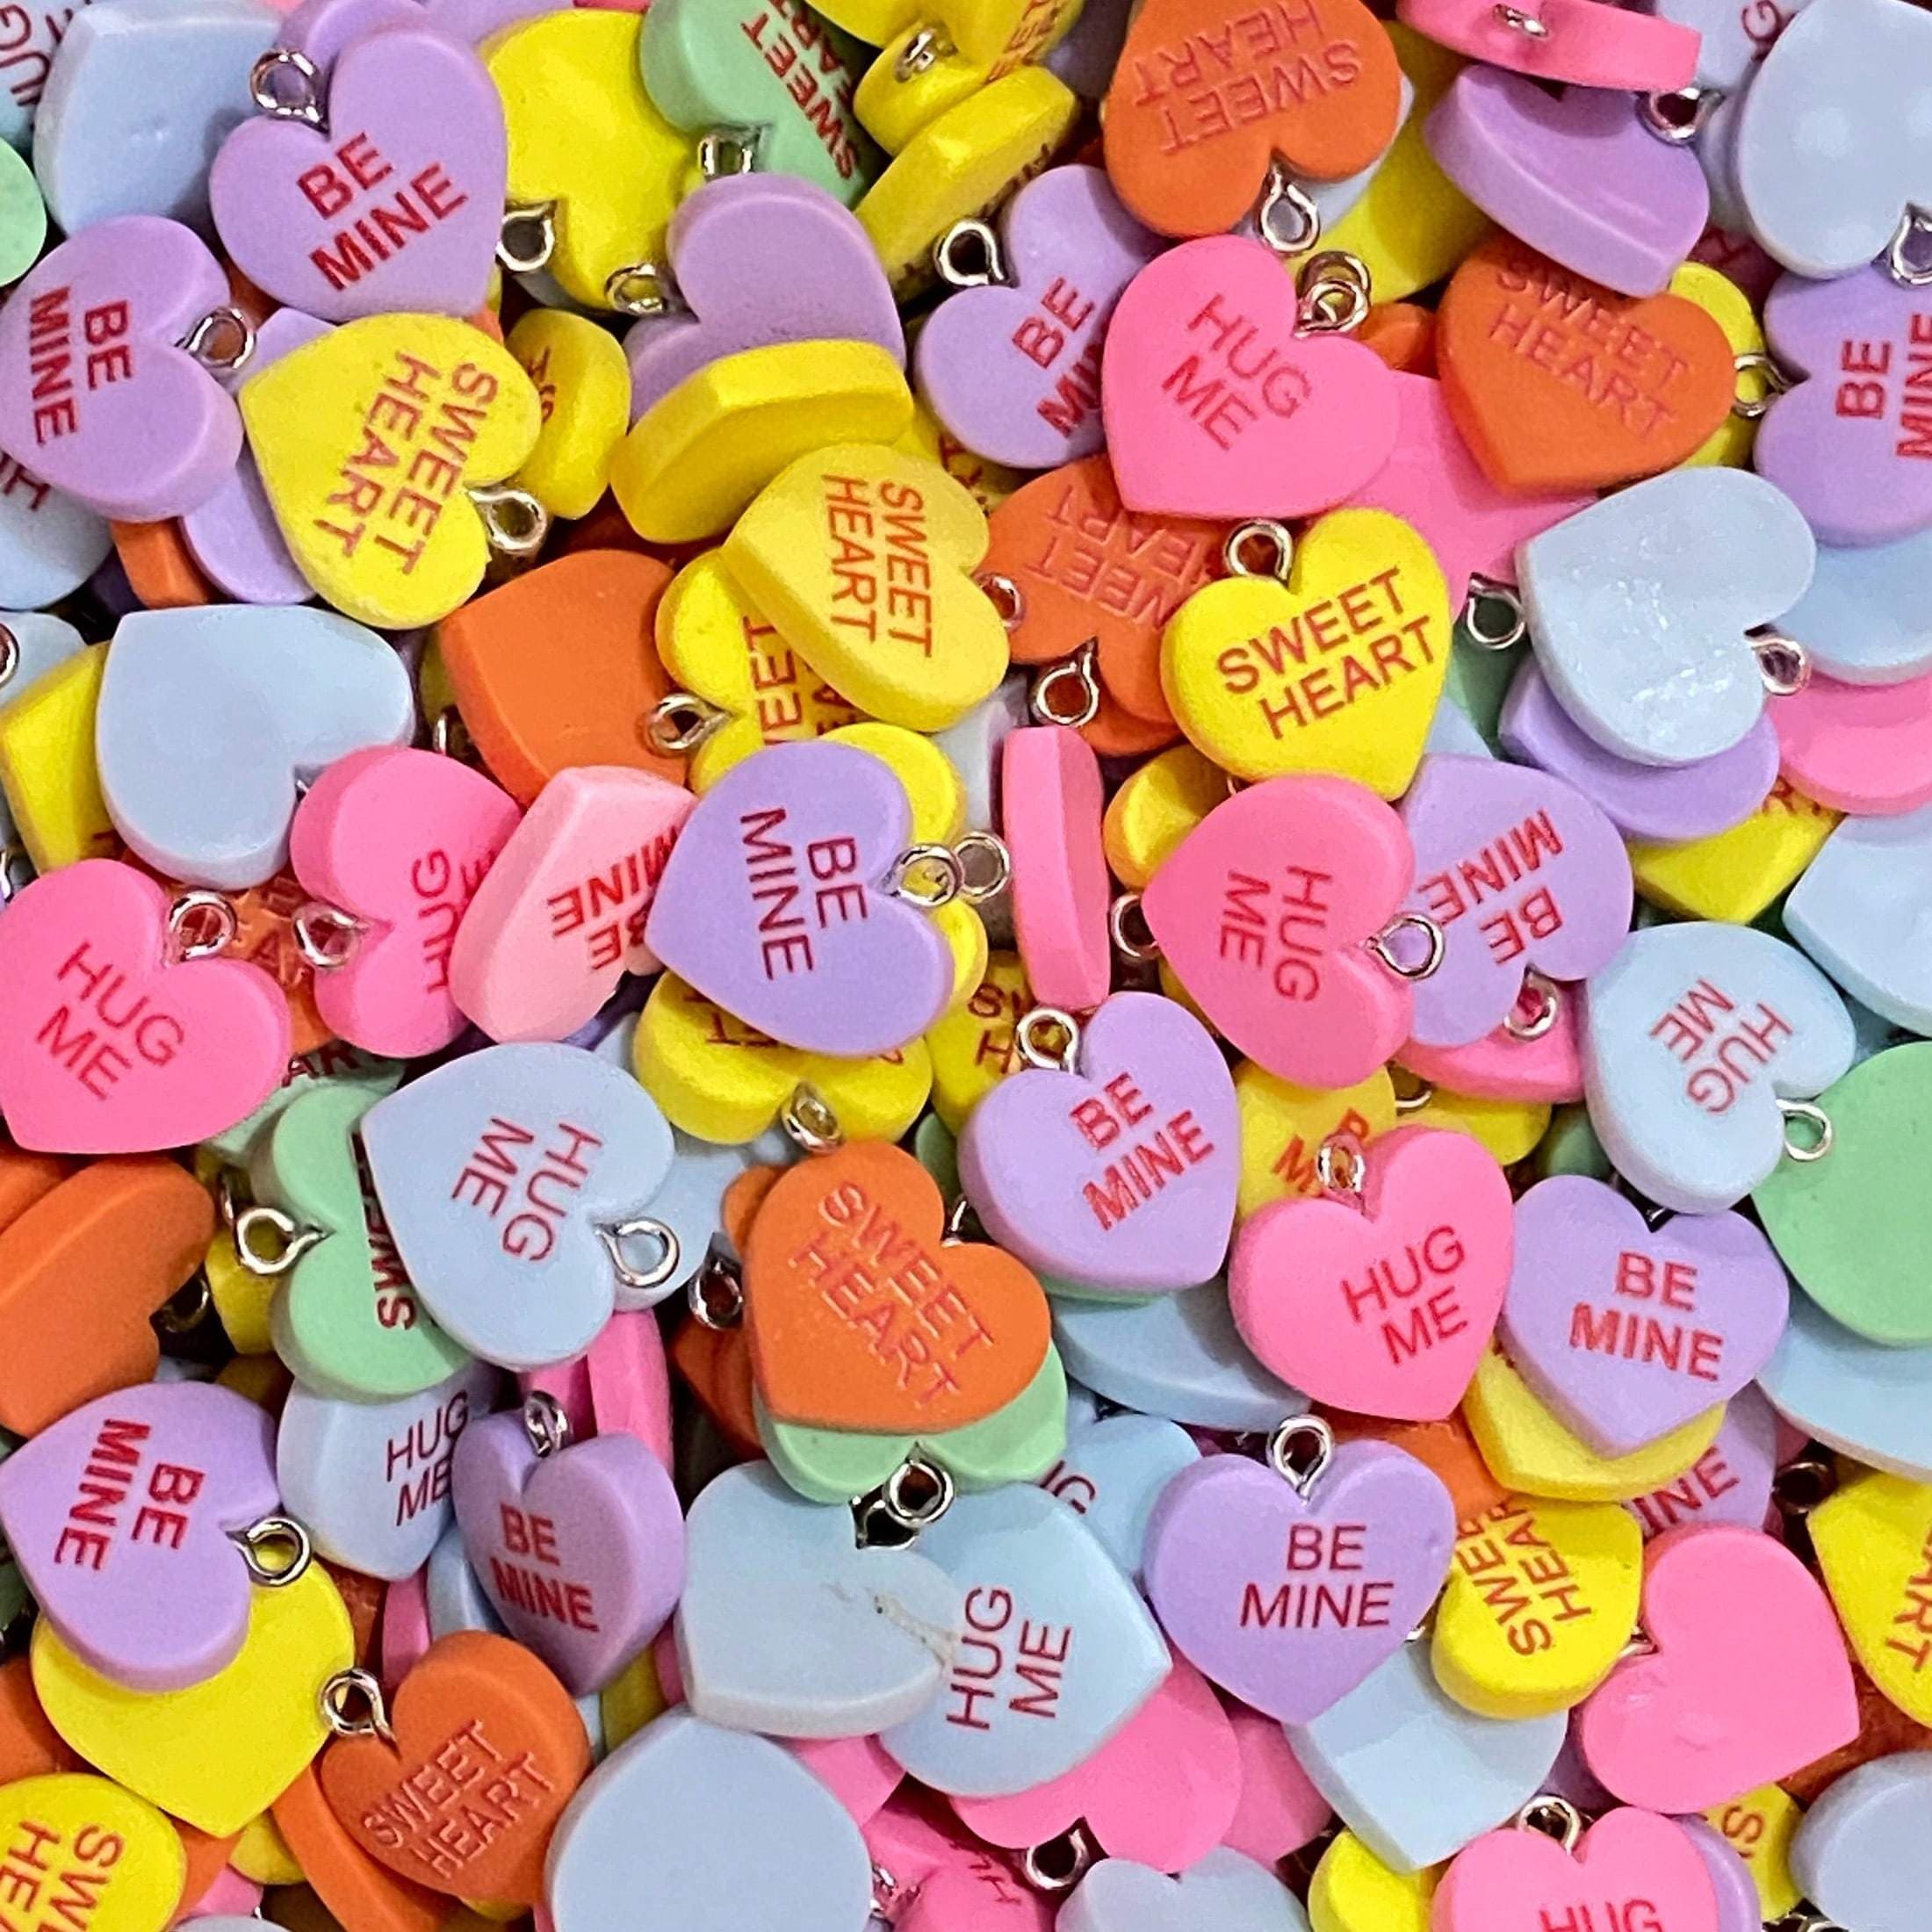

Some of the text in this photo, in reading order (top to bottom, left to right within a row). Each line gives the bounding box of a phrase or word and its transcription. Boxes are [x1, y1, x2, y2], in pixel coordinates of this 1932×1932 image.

[740, 12, 857, 180] SWEET
[1132, 0, 1327, 107] HEART
[1158, 40, 1364, 156] SWEET
[296, 132, 394, 220] BE
[308, 162, 469, 291] MINE
[29, 287, 78, 444] MINE
[84, 300, 133, 391] BE
[1011, 278, 1096, 370] BE
[1186, 292, 1312, 420] HUG
[1489, 302, 1671, 437] HEART
[1161, 355, 1257, 451] ME
[1835, 341, 1891, 420] BE
[314, 351, 441, 559] HEART
[375, 363, 499, 575] SWEET
[820, 474, 878, 643] HEART
[880, 479, 932, 658] SWEET
[1027, 537, 1177, 631] WEET
[1217, 567, 1406, 693] SWEET
[1258, 616, 1436, 740] HEART
[740, 808, 815, 980] MINE
[806, 836, 869, 929] BE
[1219, 869, 1271, 966] ME
[1417, 808, 1563, 926] MINE
[1273, 865, 1333, 1002] HUG
[1479, 885, 1564, 967] BE
[36, 1006, 133, 1100] ME
[56, 941, 185, 1069] HUG
[1648, 978, 1734, 1062] ME
[1687, 1002, 1794, 1115] HUG
[1069, 1071, 1155, 1152] BE
[451, 1115, 535, 1219] ME
[501, 1121, 602, 1263] HUG
[1082, 1109, 1215, 1231] MINE
[789, 1233, 961, 1408] HEART
[818, 1180, 994, 1359] SWEET
[1341, 1225, 1466, 1323] HUG
[1615, 1251, 1698, 1314] BE
[1381, 1285, 1468, 1367] ME
[1568, 1302, 1725, 1384] MINE
[386, 1390, 468, 1482] HUG
[396, 1456, 451, 1526] ME
[54, 1418, 154, 1572] MINE
[131, 1461, 206, 1550] BE
[500, 1503, 561, 1567] BE
[1623, 1445, 1741, 1539] INE
[489, 1556, 601, 1633] MINE
[1287, 1524, 1366, 1571] BE
[1456, 1517, 1553, 1656] SWEE
[1488, 1500, 1593, 1622] HEAR
[946, 1586, 1012, 1731] HUG
[1240, 1582, 1395, 1630] MINE
[1009, 1619, 1072, 1719] ME
[363, 1719, 504, 1849] SWEET
[412, 1751, 555, 1879] HEART
